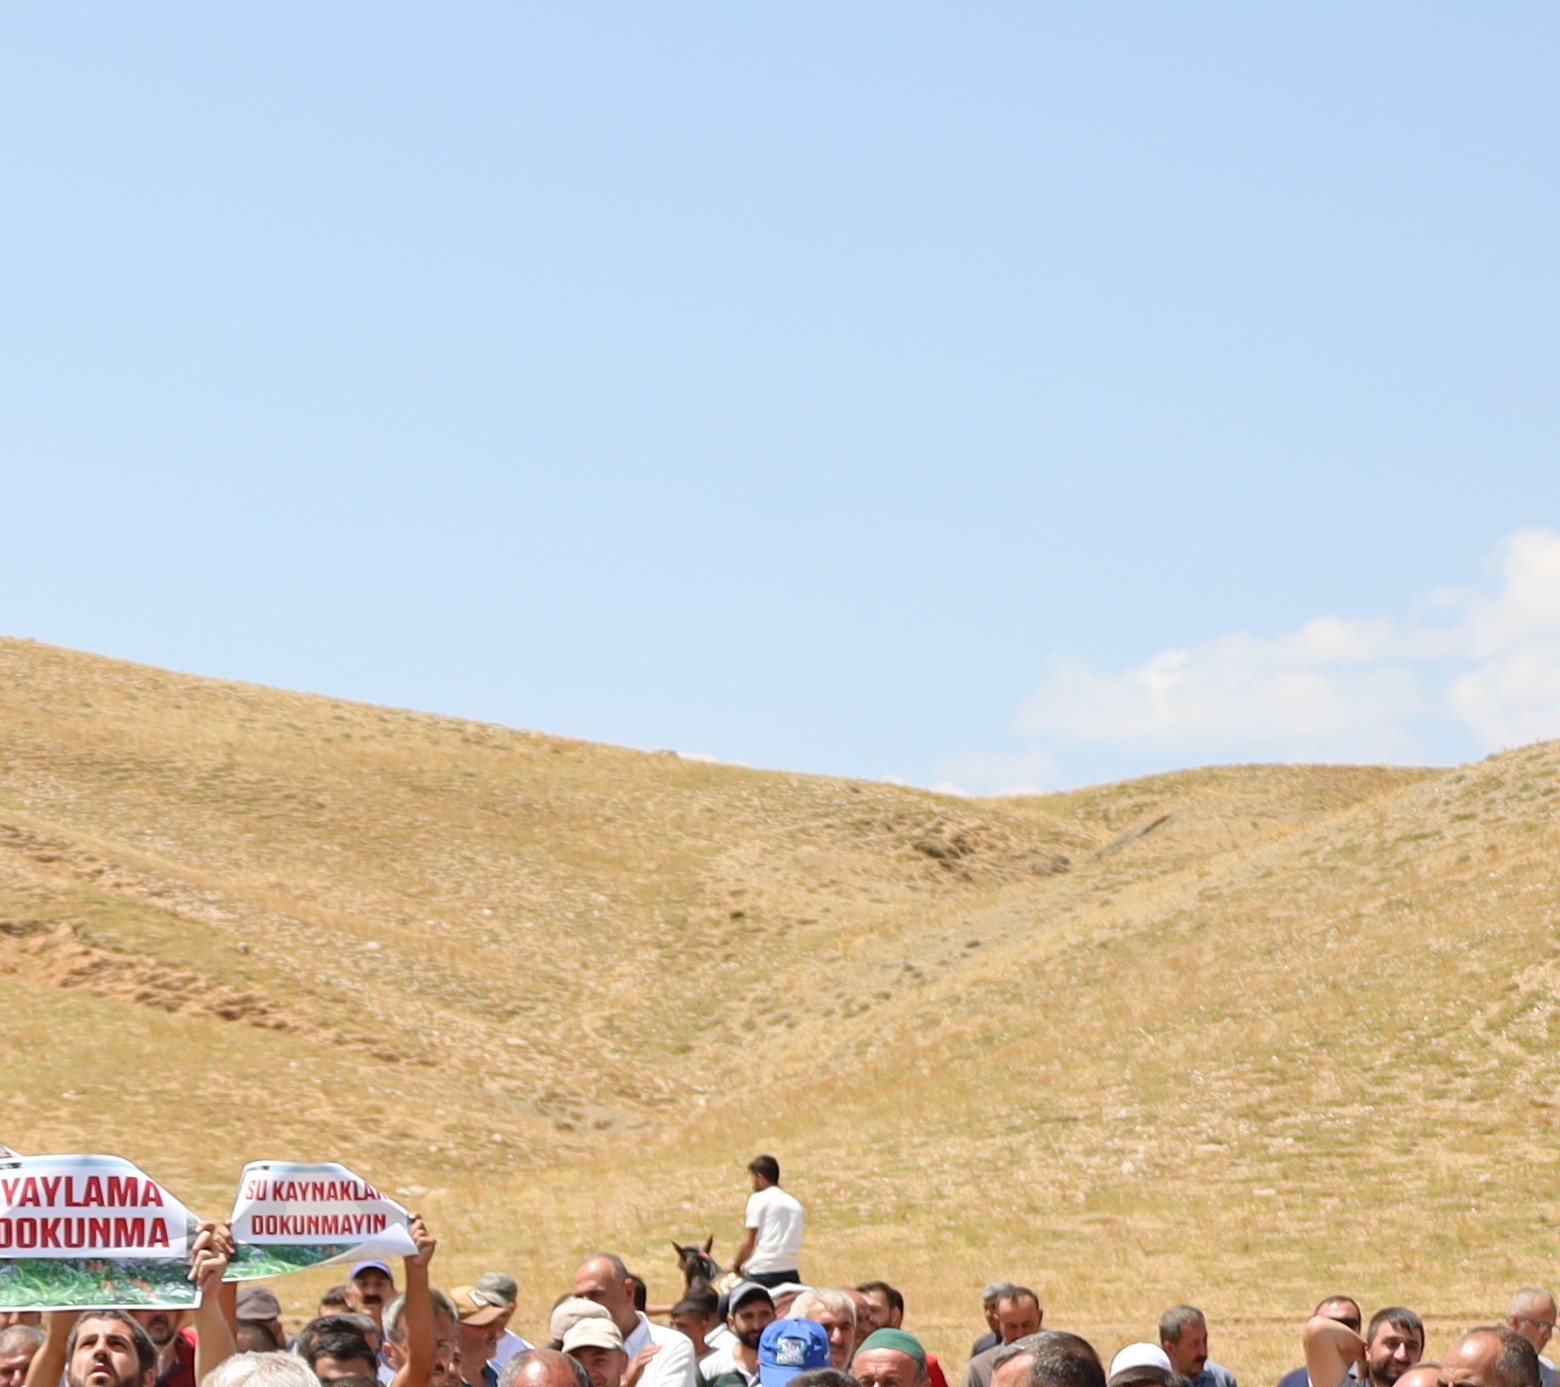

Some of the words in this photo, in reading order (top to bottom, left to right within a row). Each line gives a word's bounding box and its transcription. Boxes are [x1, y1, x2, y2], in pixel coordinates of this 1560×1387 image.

[1, 1175, 164, 1208] YAYLAMA
[246, 1179, 268, 1202] SU
[251, 1213, 387, 1236] DOKUNMAYIN
